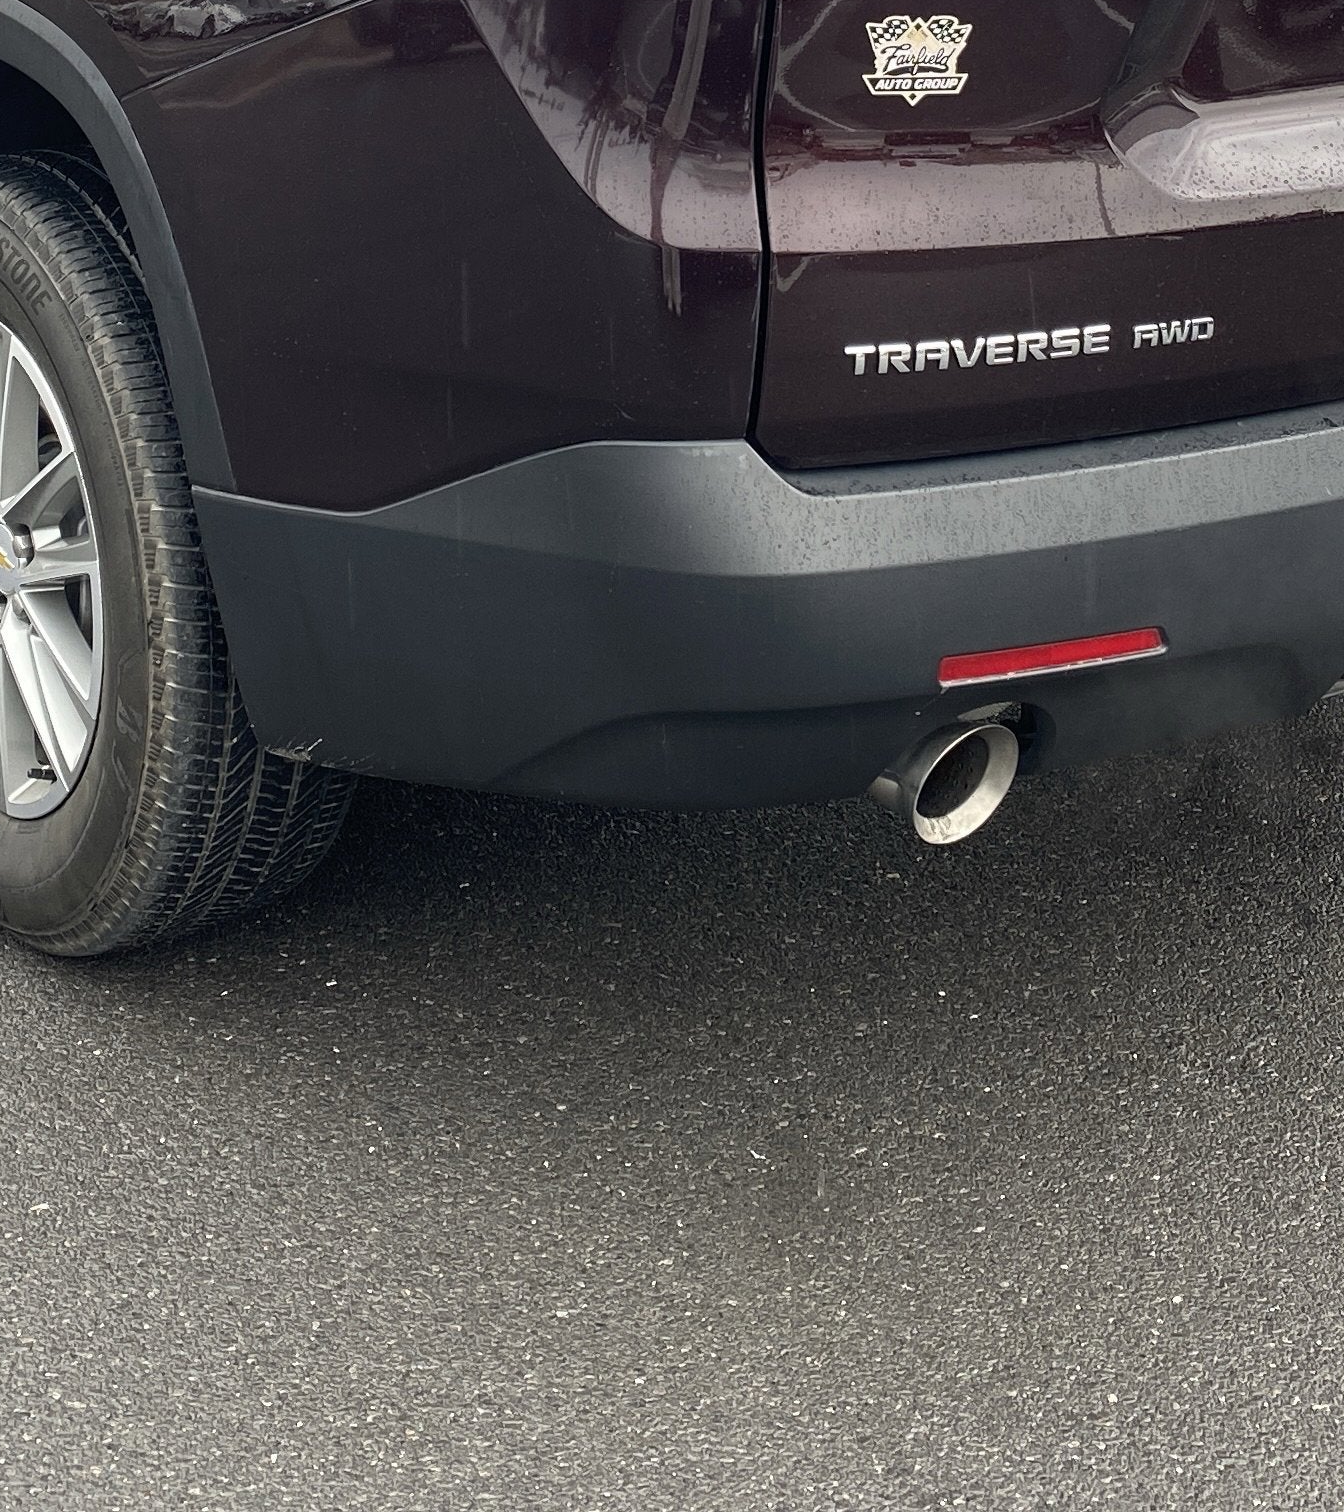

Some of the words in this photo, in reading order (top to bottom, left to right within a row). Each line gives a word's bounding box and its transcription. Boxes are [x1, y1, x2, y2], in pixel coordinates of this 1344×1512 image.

[880, 43, 956, 75] Fairfield
[875, 78, 912, 90] AUTO
[914, 78, 959, 90] GROUP
[844, 324, 1111, 375] TRAVERSE
[1133, 316, 1214, 349] AWD
